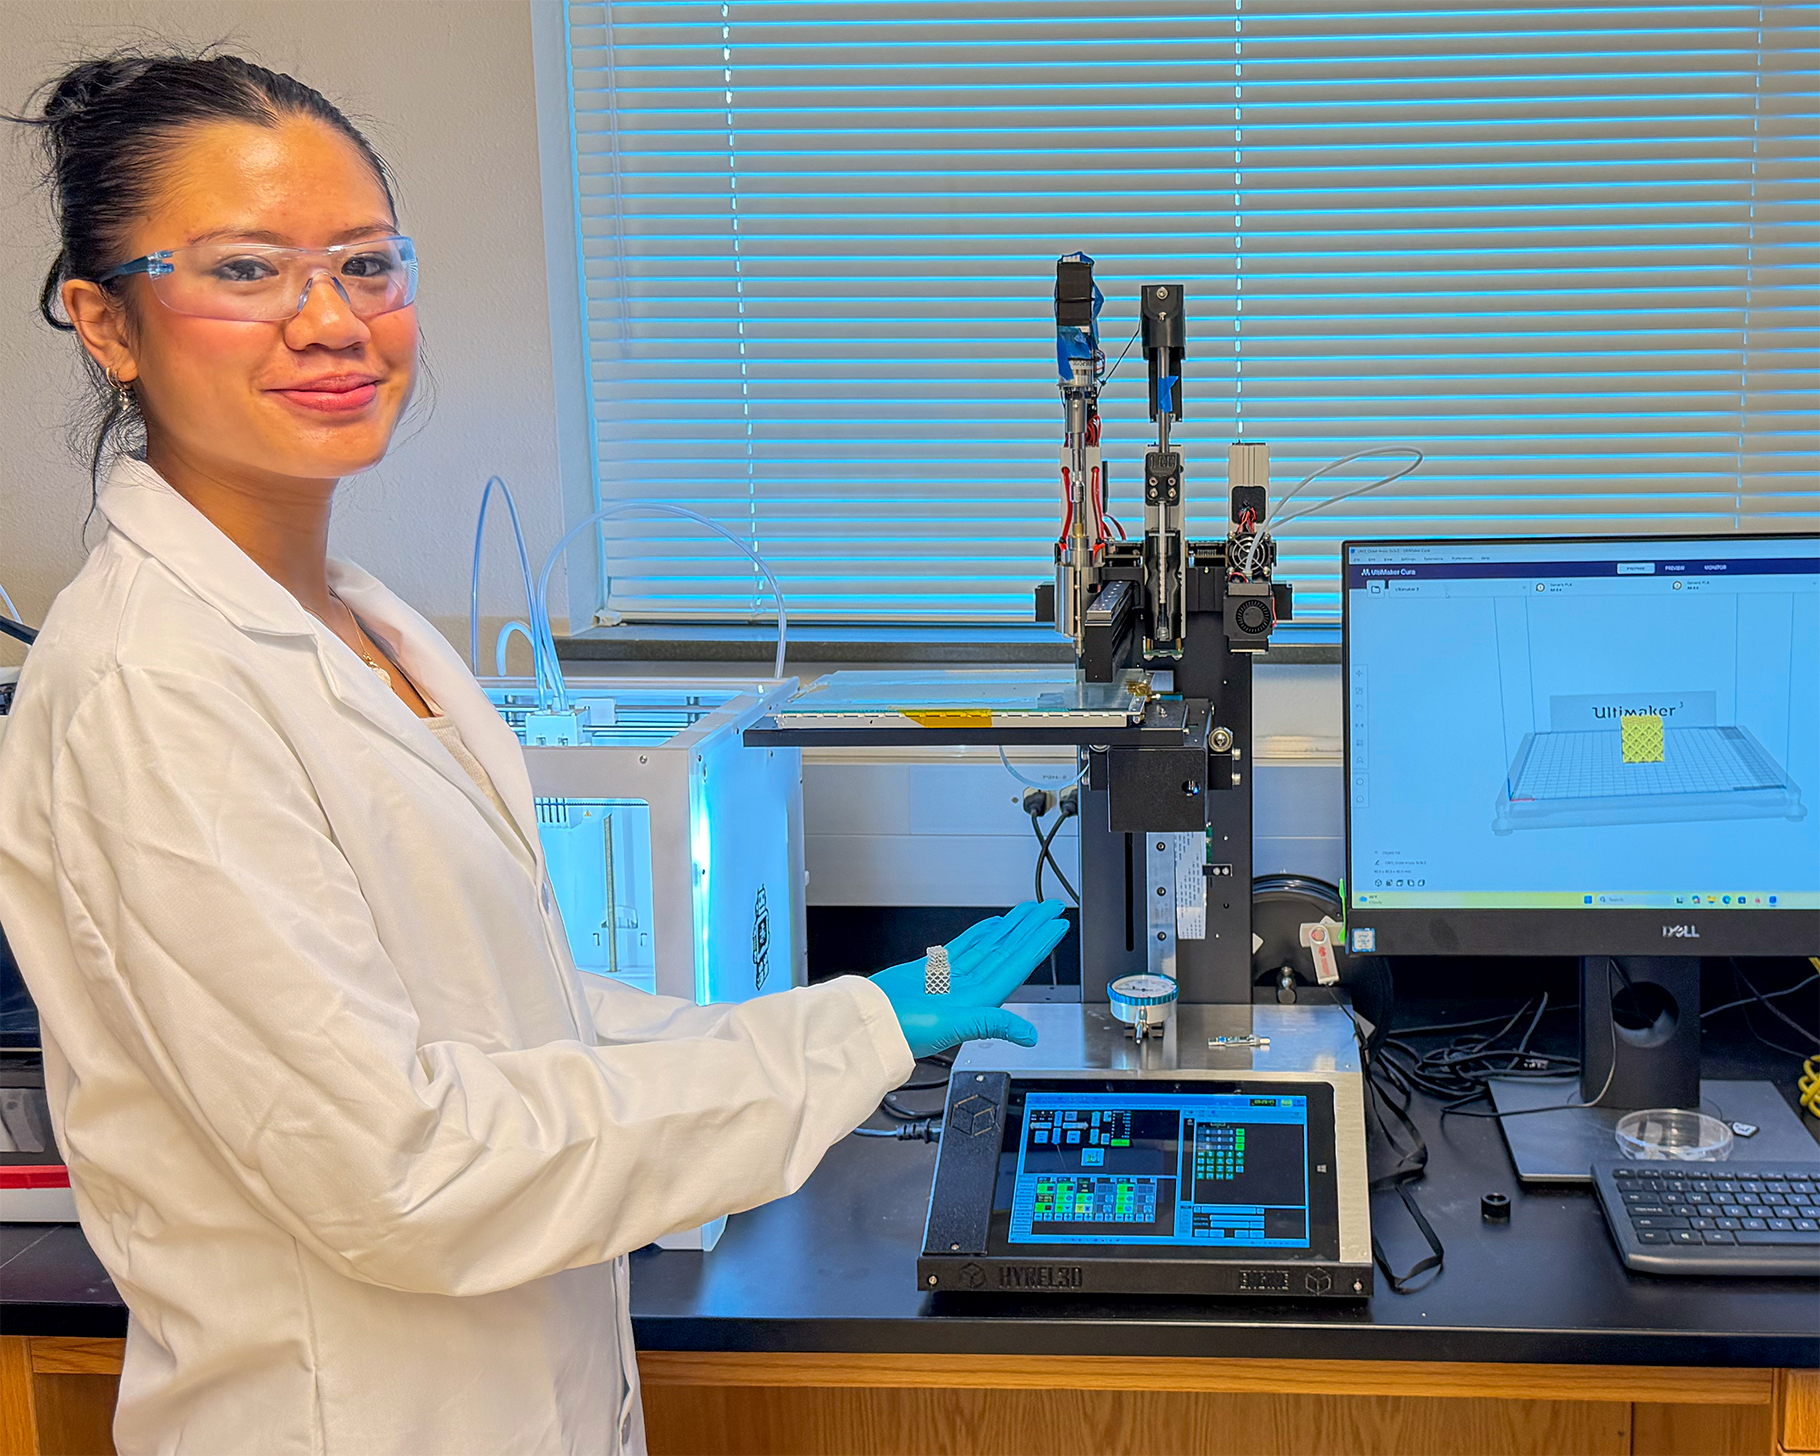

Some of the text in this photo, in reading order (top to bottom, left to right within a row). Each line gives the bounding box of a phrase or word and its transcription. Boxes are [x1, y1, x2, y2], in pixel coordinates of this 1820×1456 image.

[1371, 568, 1416, 576] UltiMaker Cura
[1592, 704, 1676, 719] Ultimaker
[1662, 925, 1700, 938] DELL
[999, 1266, 1083, 1289] HYREL3D
